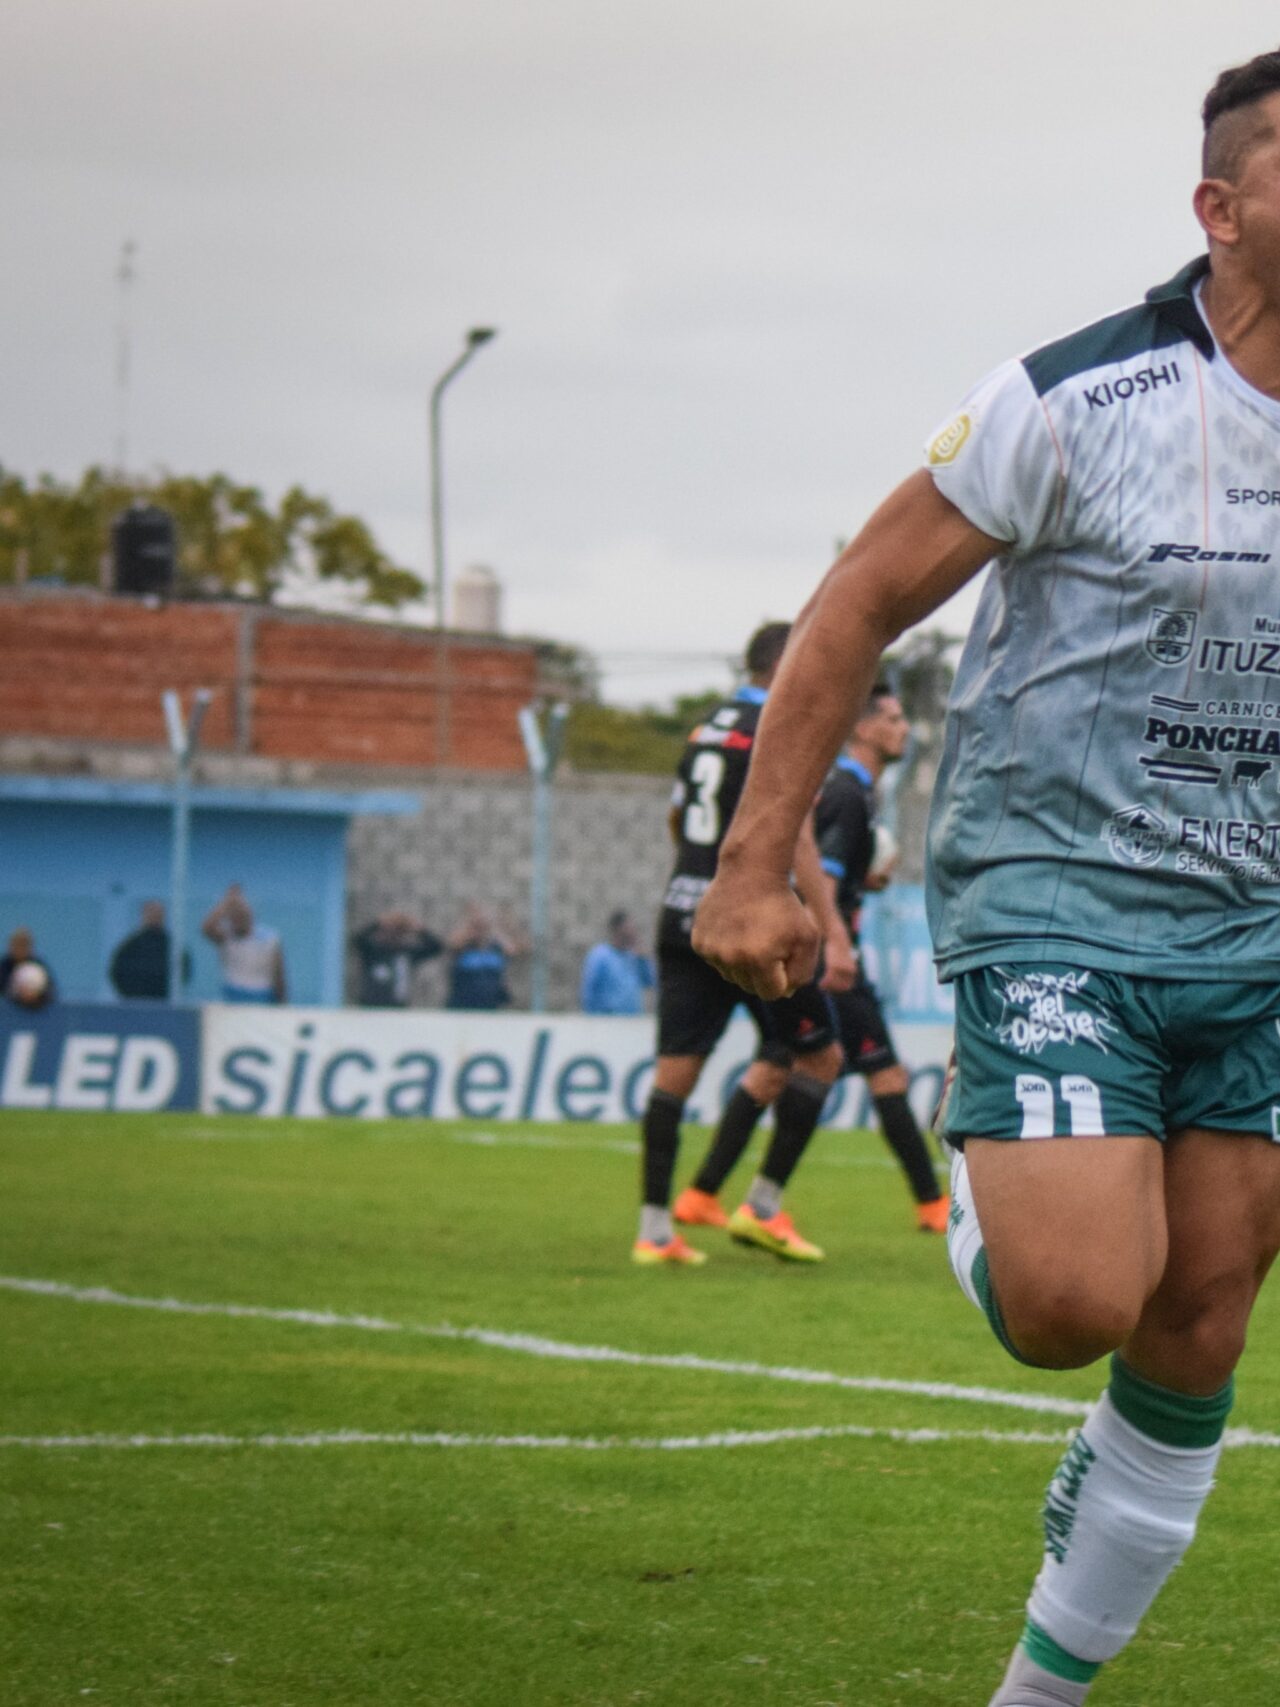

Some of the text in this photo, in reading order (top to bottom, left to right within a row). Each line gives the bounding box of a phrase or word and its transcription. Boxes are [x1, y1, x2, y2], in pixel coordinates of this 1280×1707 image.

[1083, 361, 1181, 411] KIOSHI
[684, 751, 725, 845] 3
[1, 1031, 178, 1108] LED
[1016, 1074, 1105, 1138] 11
